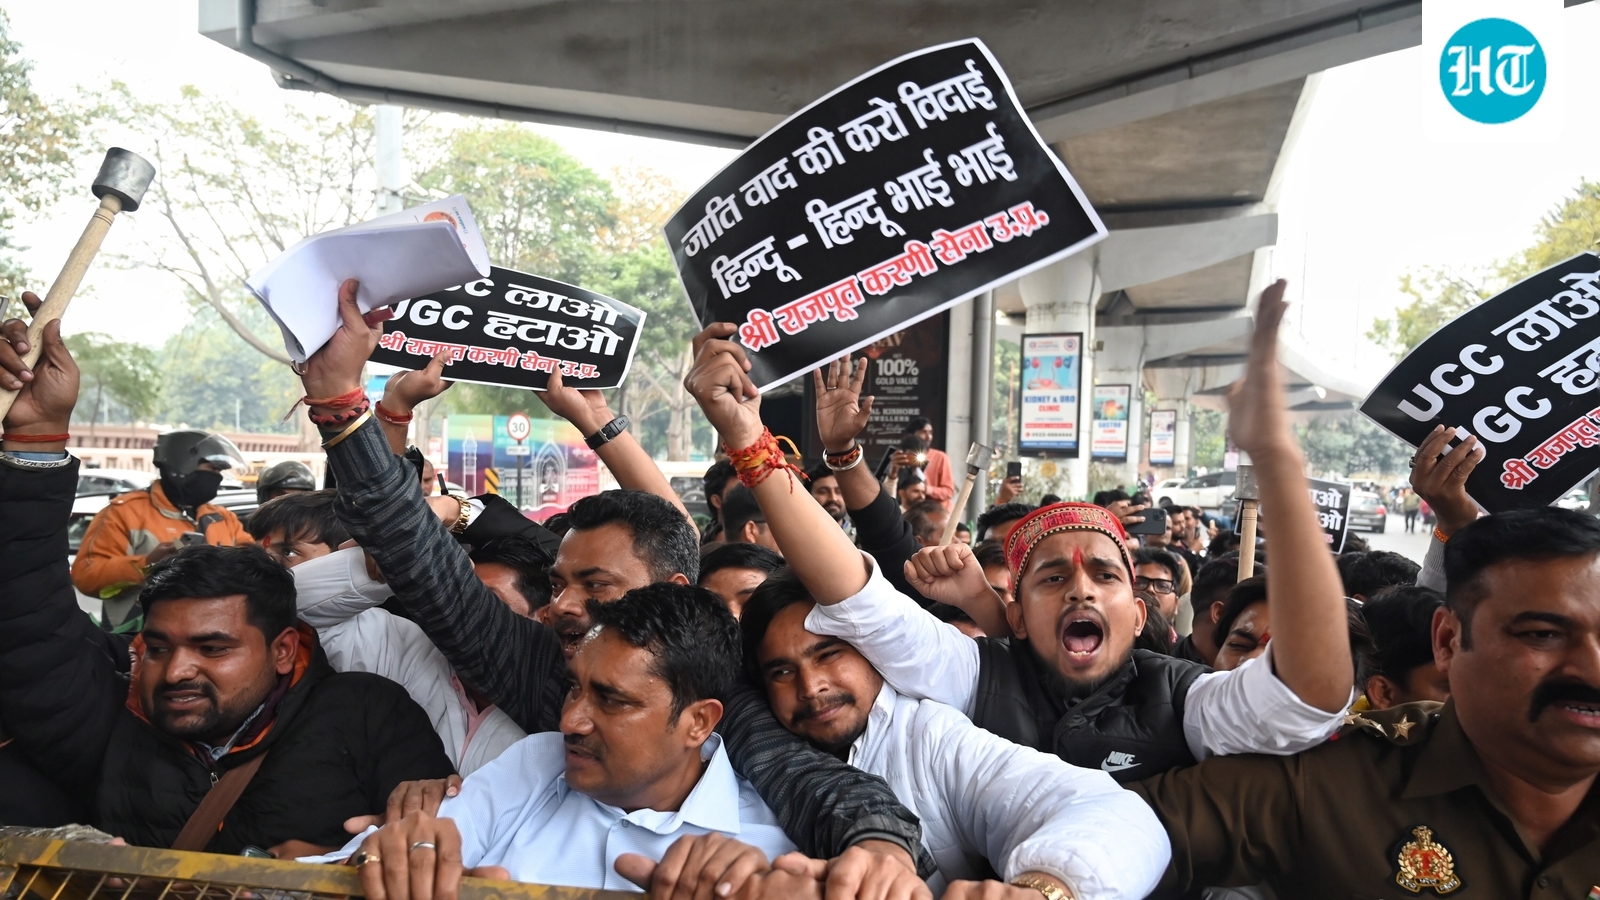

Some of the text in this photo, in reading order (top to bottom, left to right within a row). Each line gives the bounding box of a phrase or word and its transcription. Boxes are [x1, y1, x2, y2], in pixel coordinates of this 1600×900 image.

[680, 59, 997, 257] जाति वाद की करो विदाई
[711, 236, 802, 299] हिन्दू
[805, 188, 906, 249] हिन्दू
[884, 148, 954, 213] भाई
[948, 121, 1018, 186] भाई
[739, 201, 1050, 352] श्री राजपूत करणी सेना उ.प्र.
[504, 283, 623, 326] लाओ
[379, 331, 407, 351] श्री
[467, 345, 521, 369] करणी
[483, 311, 624, 356] हटाओ
[875, 377, 918, 385] GOLD VALUE
[876, 358, 919, 376] 100%
[1397, 344, 1504, 422] UCC
[1024, 395, 1051, 403] KIDNEY
[1060, 395, 1076, 403] URO
[512, 422, 526, 433] 30
[1500, 458, 1539, 490] श्री
[1107, 751, 1135, 766] NIKE
